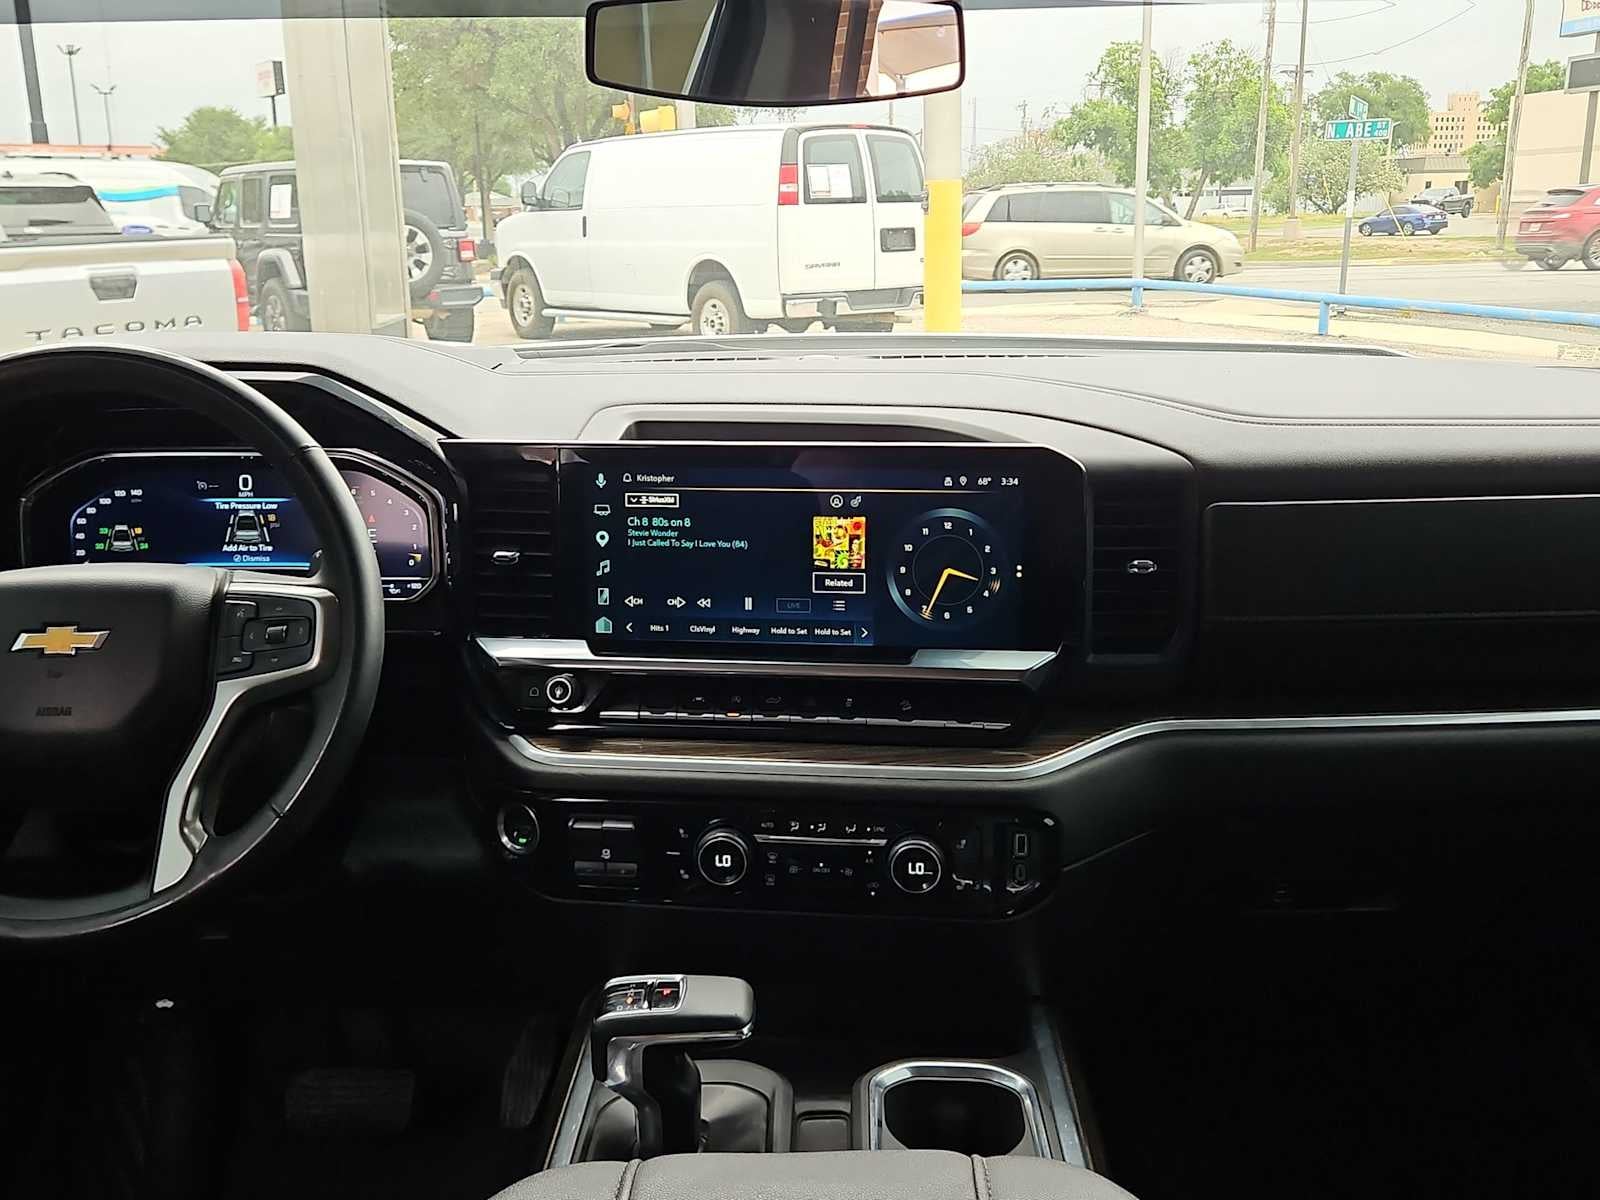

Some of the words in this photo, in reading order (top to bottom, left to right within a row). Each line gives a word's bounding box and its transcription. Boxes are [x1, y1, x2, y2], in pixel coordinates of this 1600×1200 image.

[1327, 123, 1340, 138] N.
[1345, 122, 1372, 138] ABE
[26, 316, 202, 341] TACOMA
[239, 474, 252, 491] 0
[636, 474, 675, 483] Kristopher
[1001, 477, 1019, 486] 3:34
[627, 517, 641, 526] Ch
[642, 517, 648, 526] 8
[652, 517, 669, 526] 80s
[684, 518, 691, 526] 8
[944, 522, 953, 530] 12
[627, 529, 649, 537] Stevie
[651, 529, 678, 537] Wonder
[631, 539, 646, 548] Just
[647, 539, 670, 547] Called
[671, 539, 680, 547] To
[681, 540, 694, 550] Say
[904, 544, 913, 552] 10
[825, 578, 853, 587] Related
[732, 626, 760, 635] Highway
[840, 628, 851, 636] Set
[908, 862, 925, 875] LO
